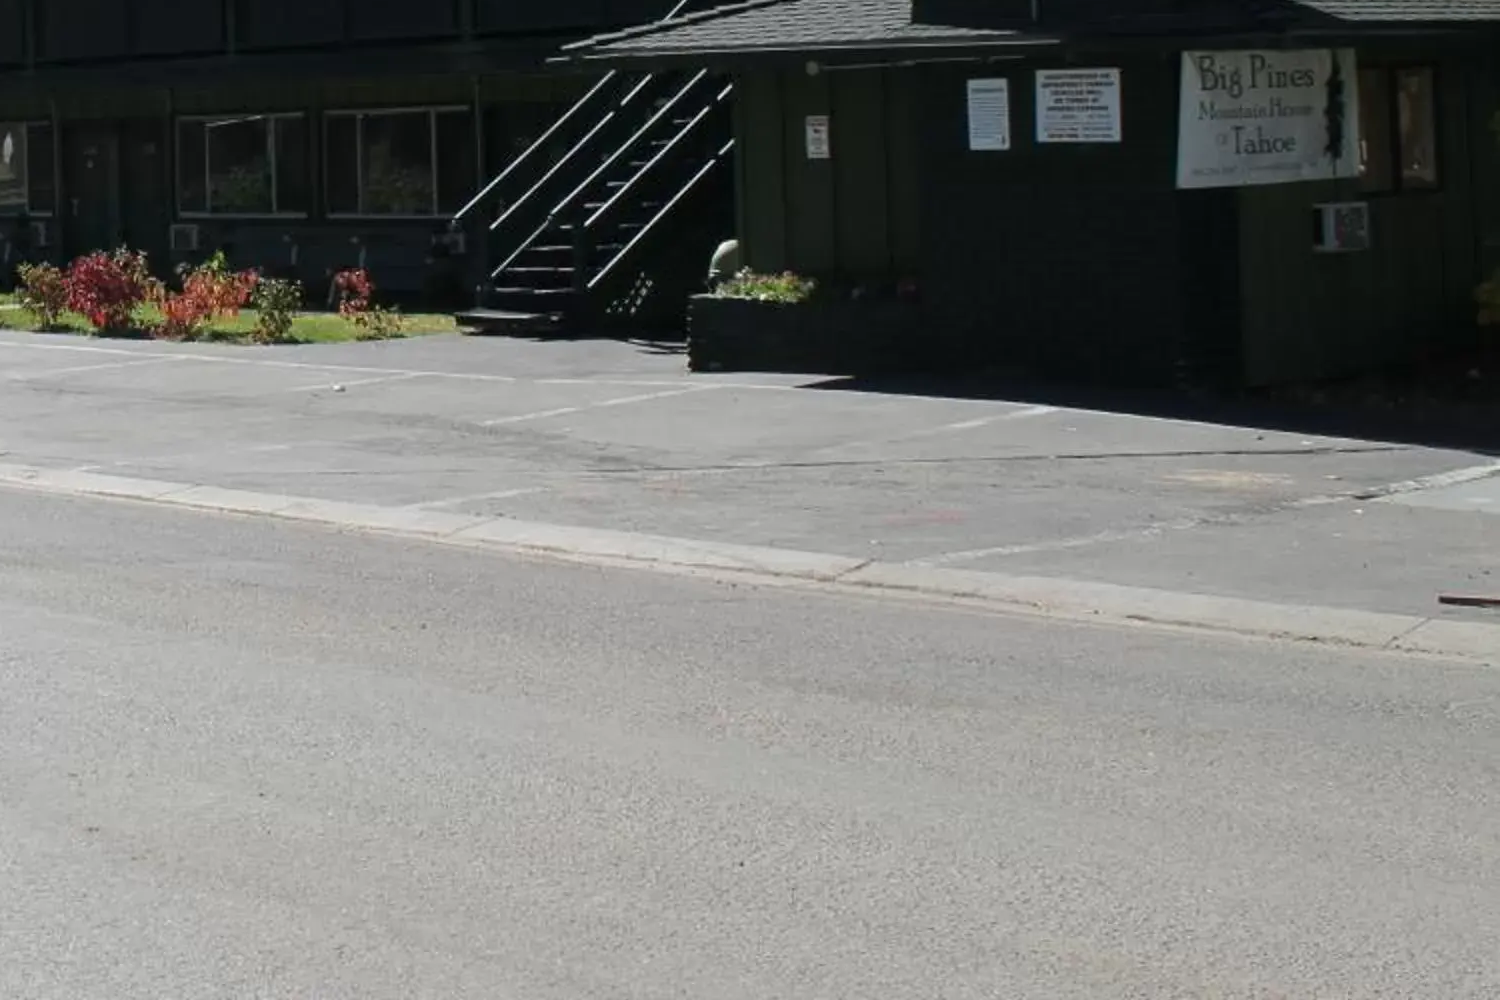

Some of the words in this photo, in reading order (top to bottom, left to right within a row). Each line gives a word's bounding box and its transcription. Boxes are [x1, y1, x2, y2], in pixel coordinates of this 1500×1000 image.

[1197, 54, 1243, 99] Big
[1248, 54, 1316, 89] Pines
[1230, 125, 1297, 156] Tahoe
